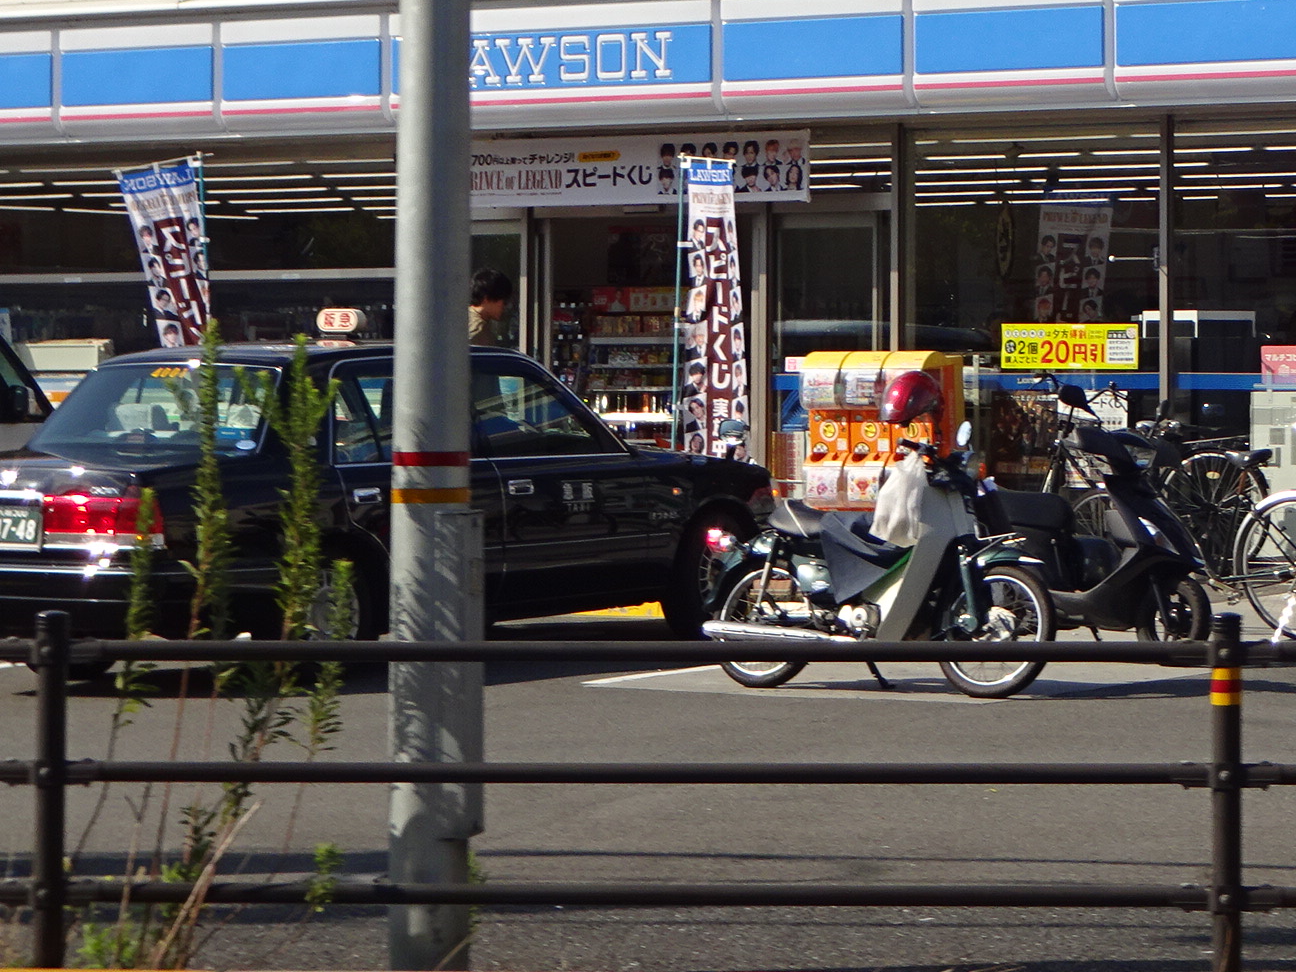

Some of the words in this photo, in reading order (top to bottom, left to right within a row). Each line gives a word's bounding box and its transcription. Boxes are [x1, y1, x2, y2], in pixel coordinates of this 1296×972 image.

[468, 31, 673, 87] AWSON
[470, 170, 504, 191] RINCE
[518, 168, 562, 190] LEGEND
[565, 164, 652, 188] スピードくじ
[689, 168, 731, 182] LAWSON
[323, 312, 353, 328] 阪急
[567, 503, 591, 512] TAXI
